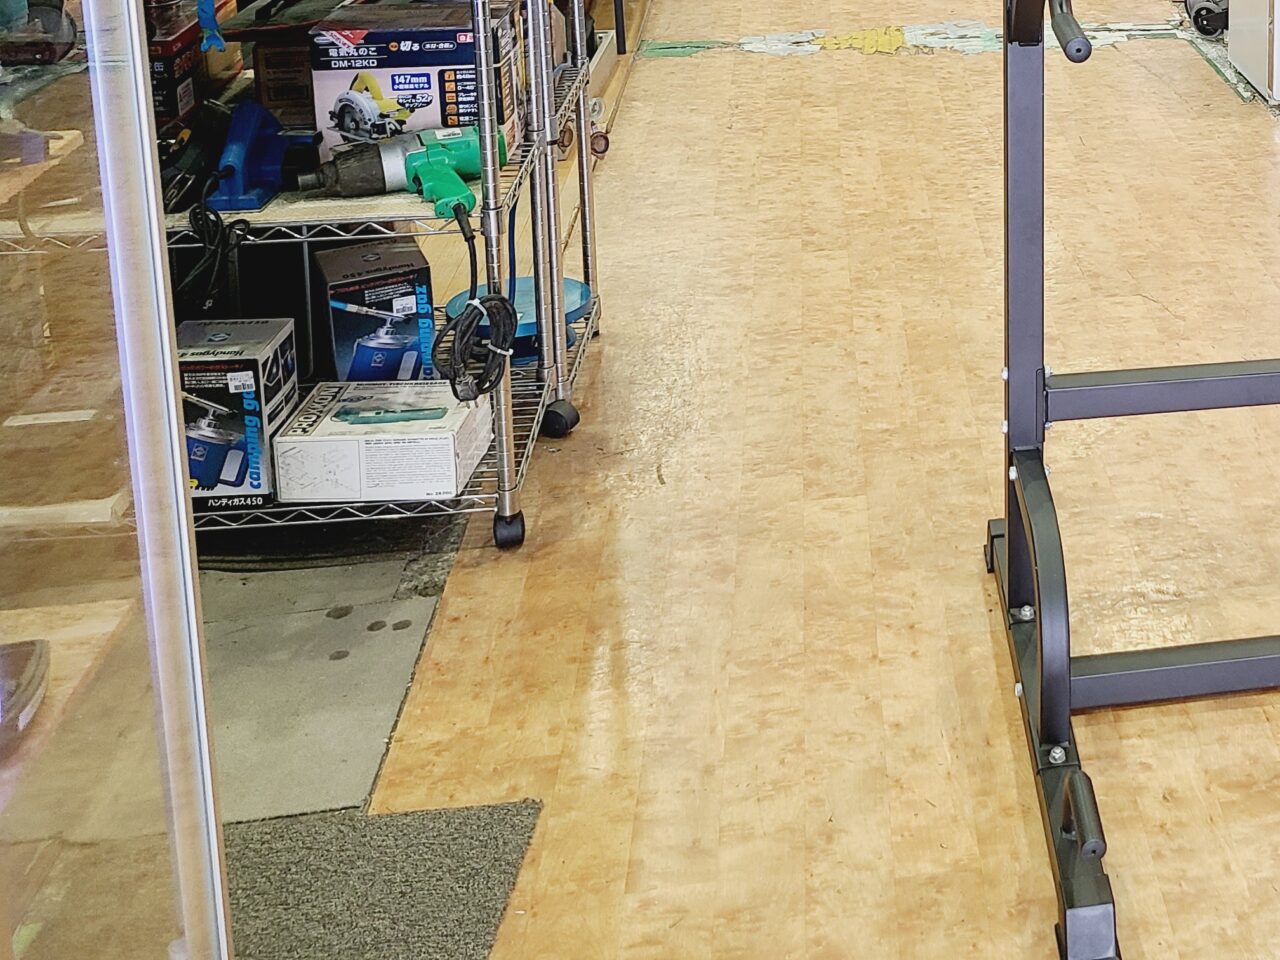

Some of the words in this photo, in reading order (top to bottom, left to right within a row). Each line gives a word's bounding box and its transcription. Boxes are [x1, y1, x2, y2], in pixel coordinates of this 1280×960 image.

[400, 41, 420, 51] 切る
[329, 46, 378, 57] 電気丸のこ
[331, 59, 378, 68] DM-12KD
[394, 75, 427, 84] 147mm
[416, 284, 432, 316] gaz
[288, 385, 344, 435] PROXXON
[244, 415, 262, 489] camping
[208, 497, 263, 507] ハンディガス450
